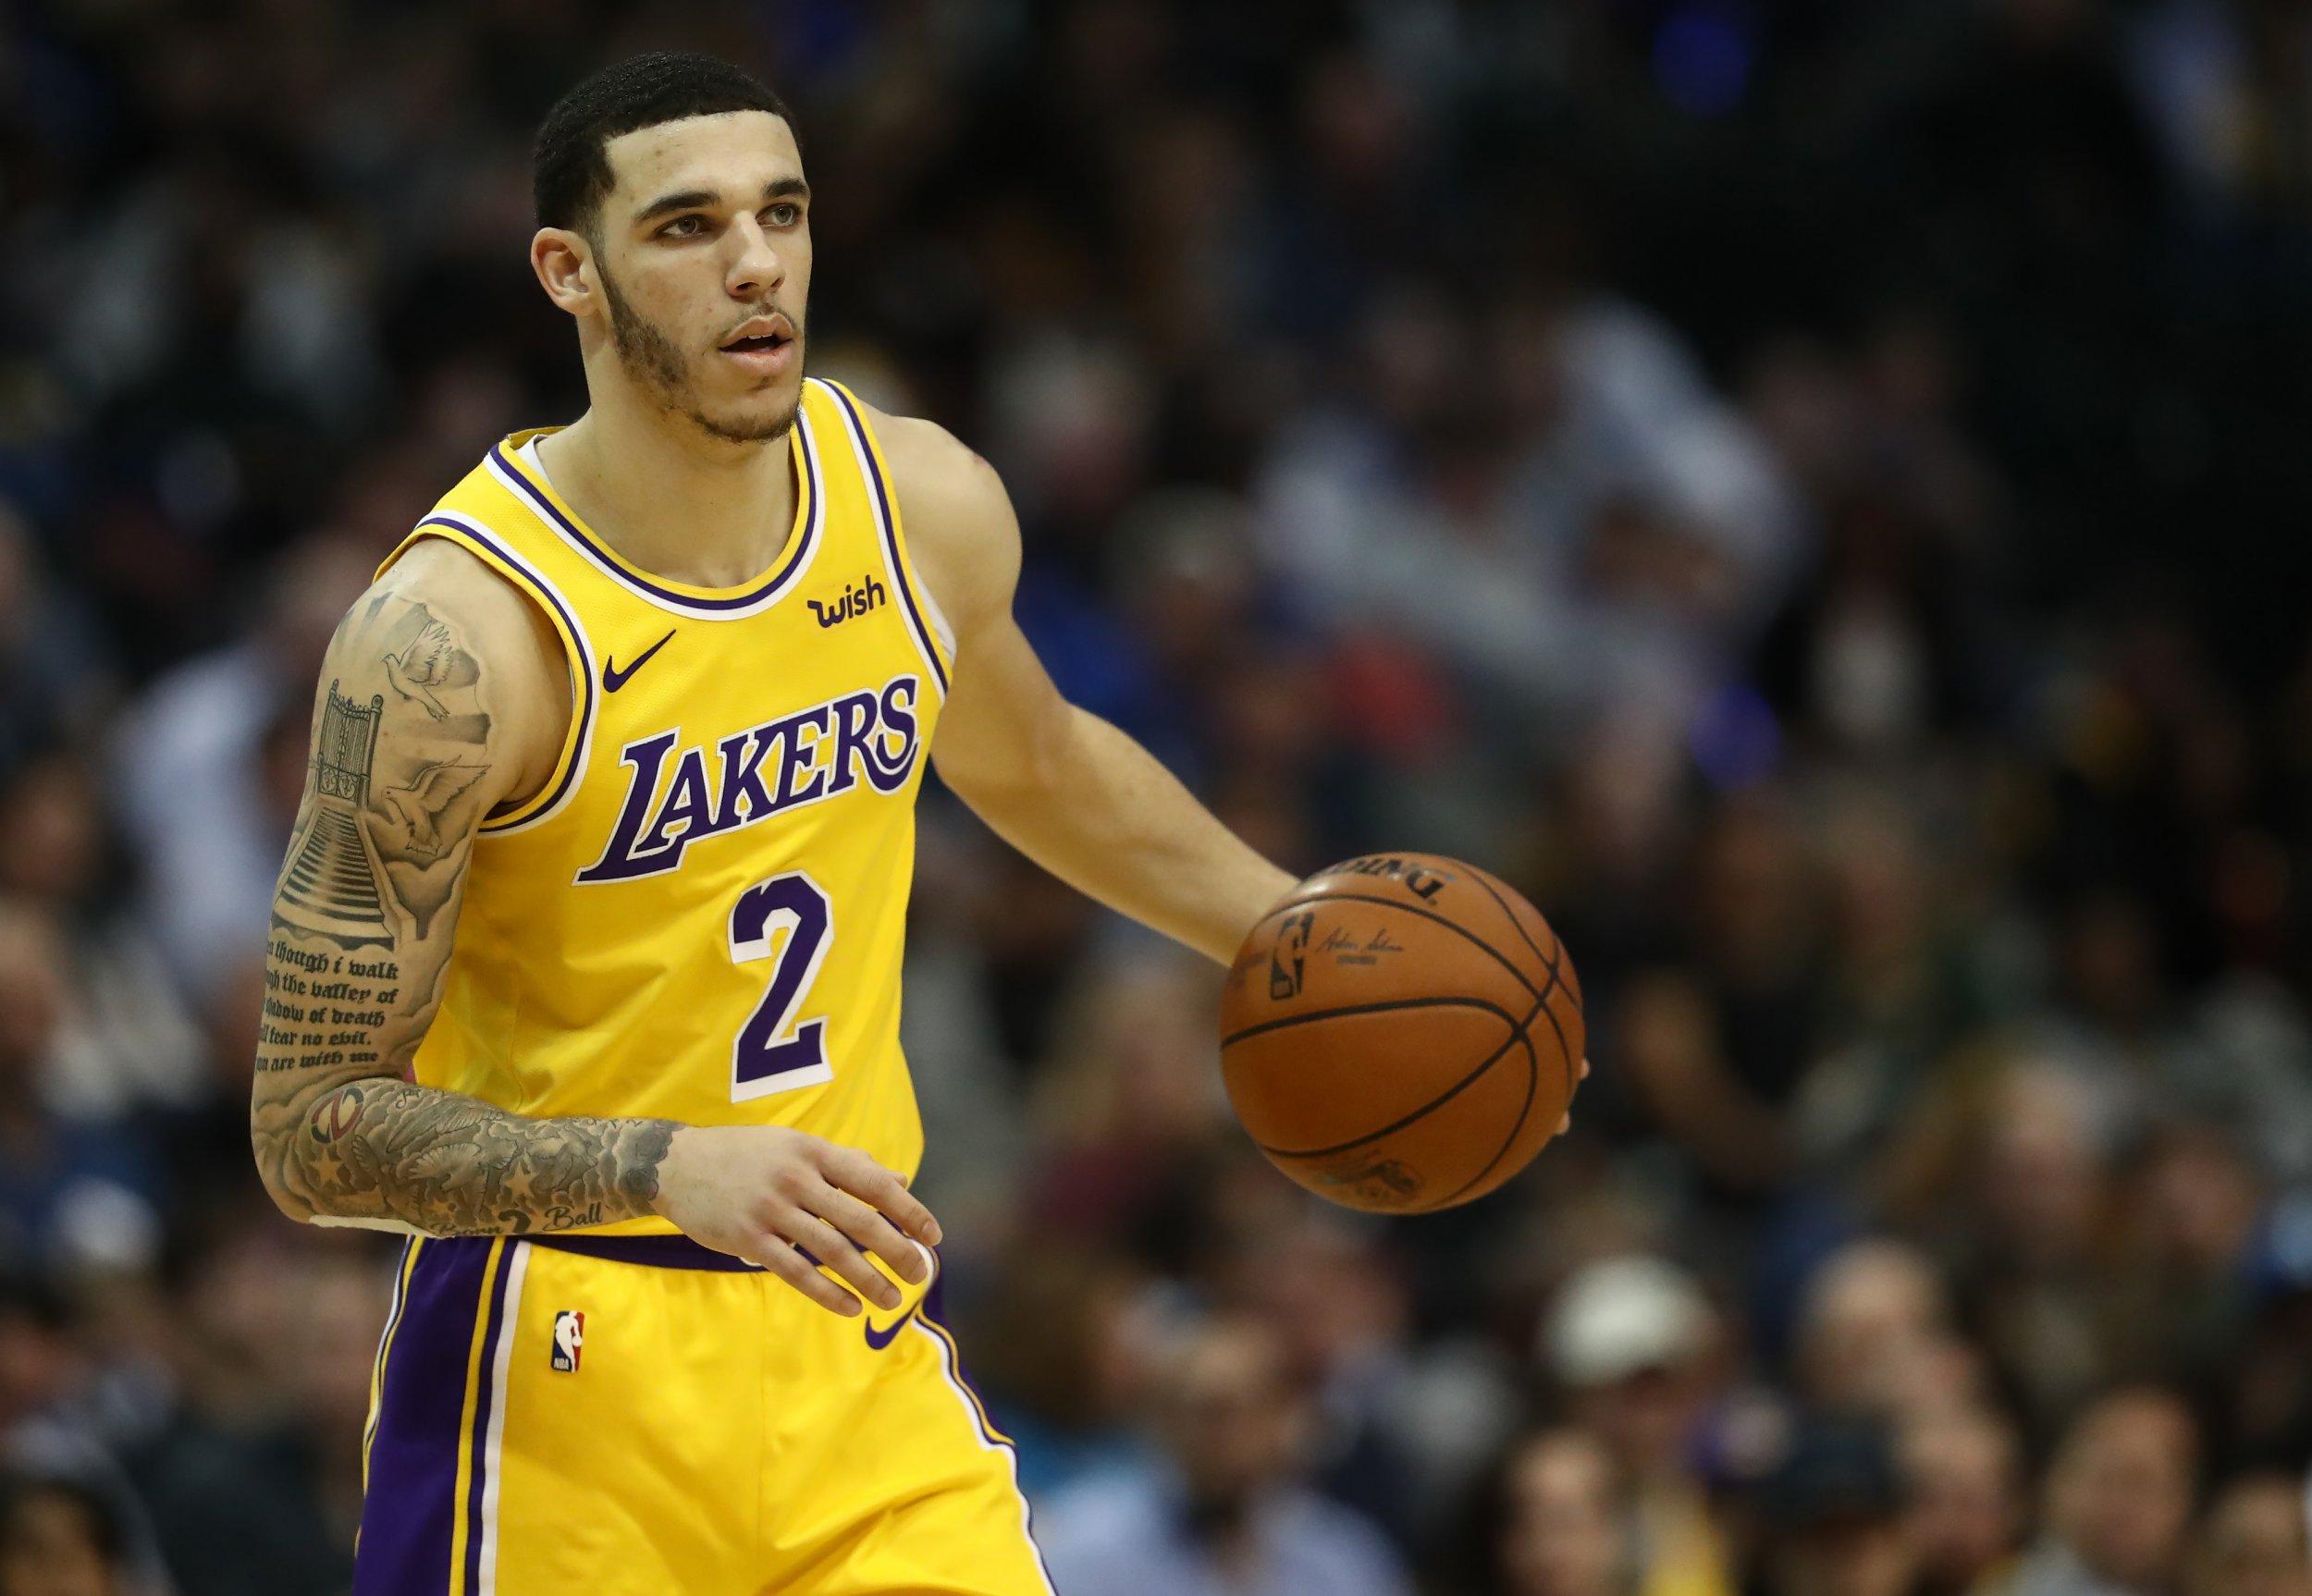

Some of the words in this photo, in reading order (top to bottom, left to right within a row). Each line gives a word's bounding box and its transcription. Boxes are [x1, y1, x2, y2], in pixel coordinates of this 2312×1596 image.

[807, 574, 886, 628] wish
[572, 672, 920, 886] LAKERS
[276, 940, 329, 974] though
[349, 960, 400, 981] walk
[282, 972, 307, 995] the
[311, 980, 371, 1004] valley
[376, 988, 400, 1004] of
[728, 869, 834, 1104] 2
[309, 1007, 326, 1024] of
[301, 1034, 323, 1046] no
[271, 1055, 296, 1073] are
[300, 1050, 343, 1068] with
[349, 1051, 378, 1063] me
[543, 1202, 603, 1232] Ball
[553, 1357, 570, 1370] NBA
